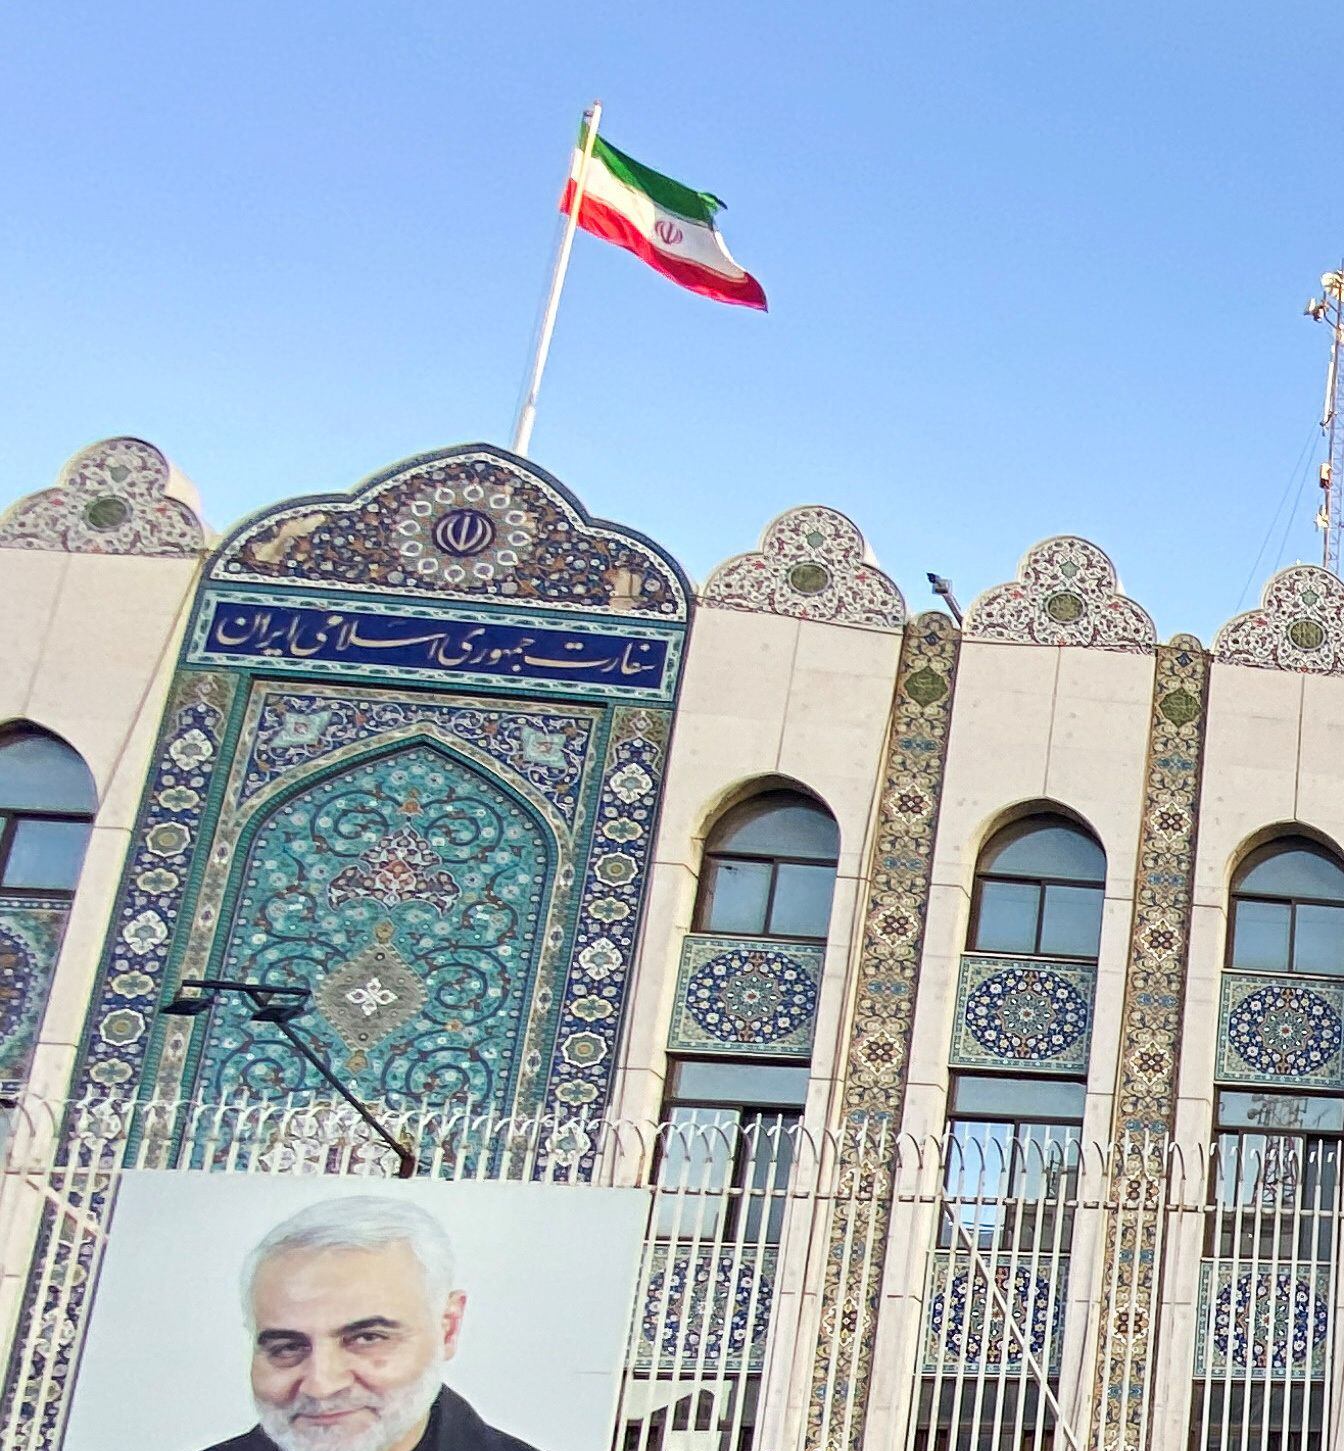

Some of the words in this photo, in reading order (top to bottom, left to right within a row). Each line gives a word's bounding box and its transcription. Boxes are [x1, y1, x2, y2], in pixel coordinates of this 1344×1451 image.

[216, 612, 300, 657] ایران
[291, 615, 447, 660] اسلامی
[438, 628, 536, 673] جمهوری
[523, 642, 656, 675] سفارت
